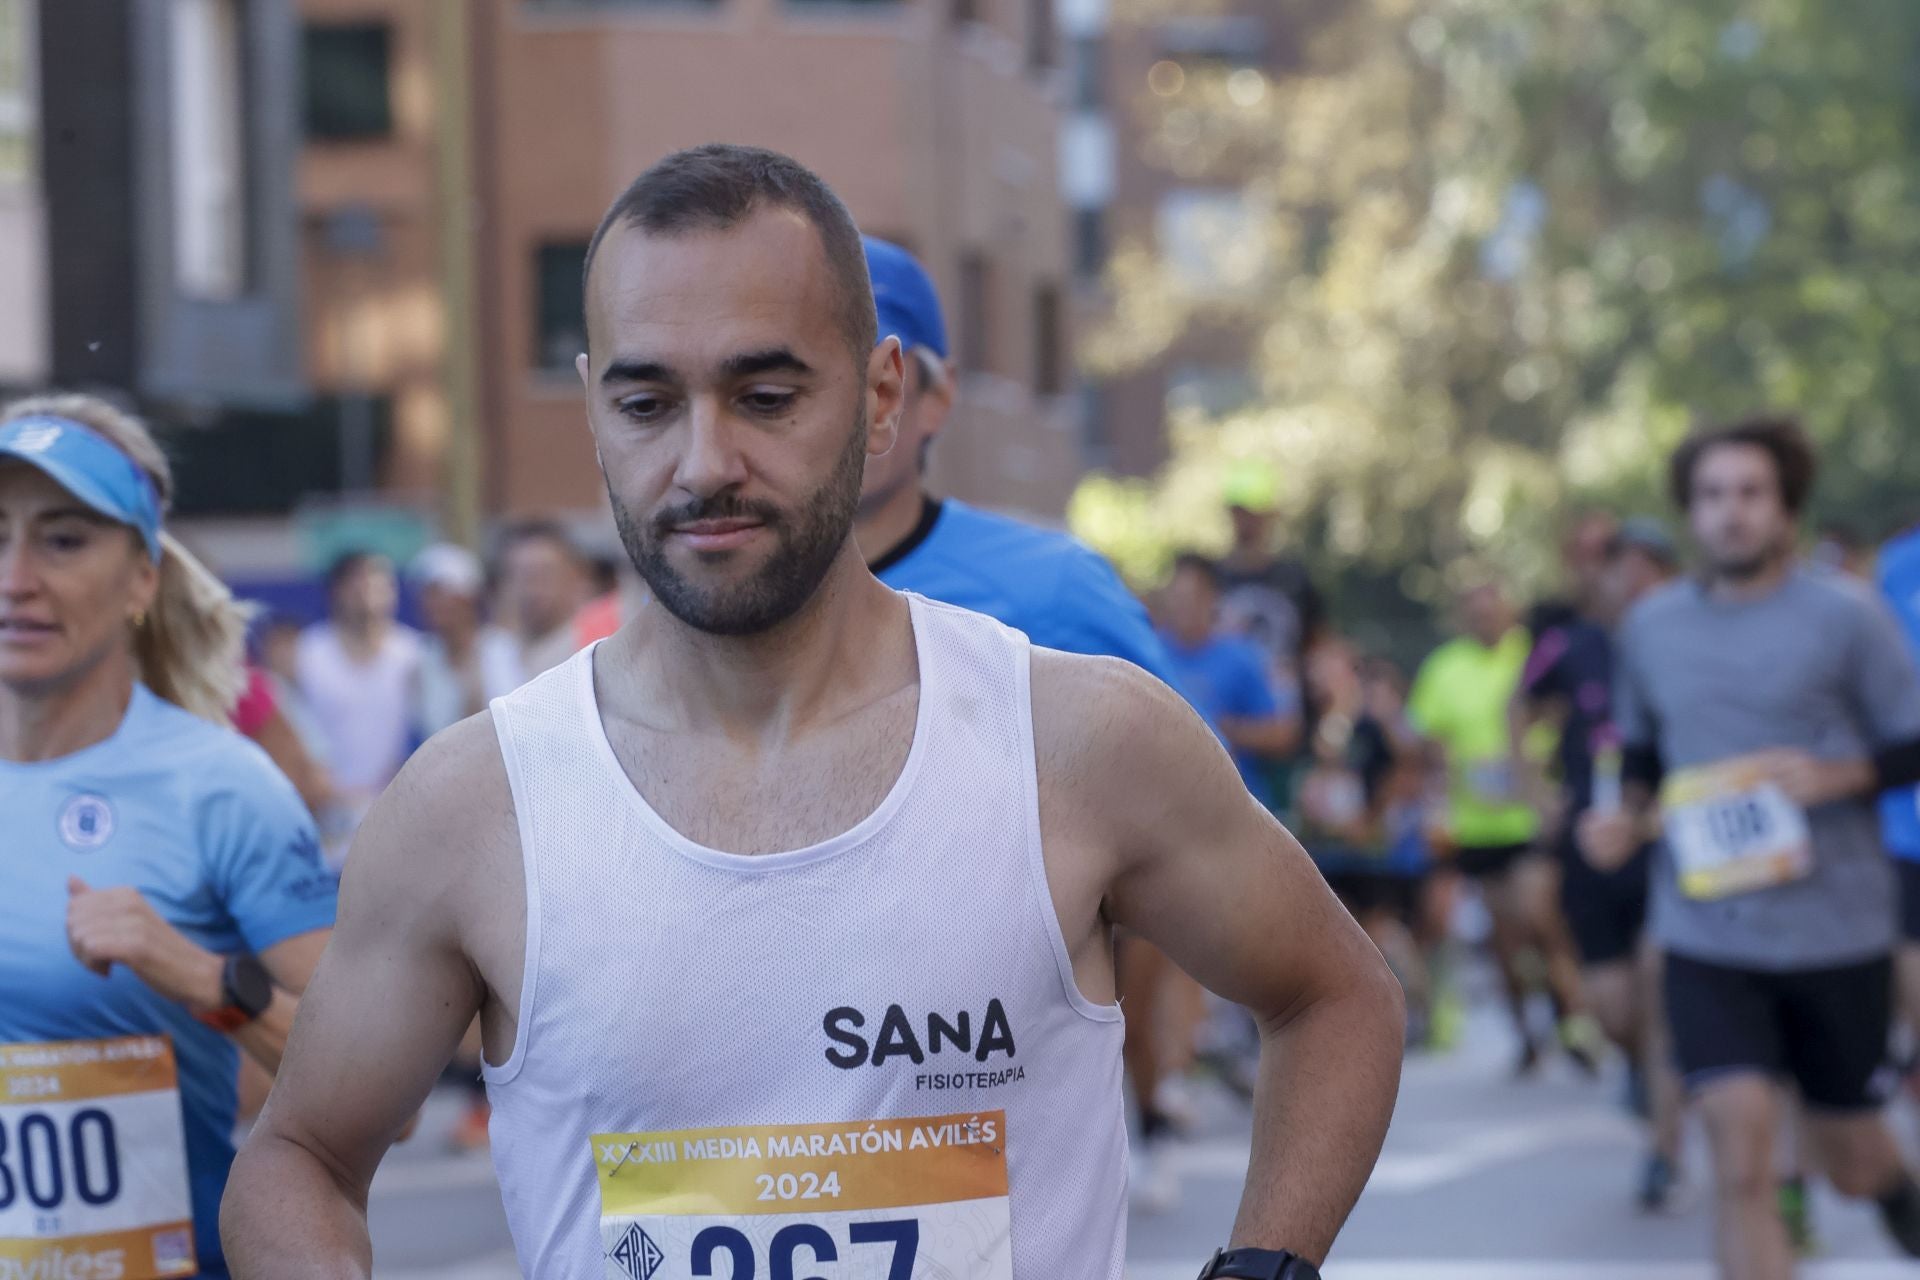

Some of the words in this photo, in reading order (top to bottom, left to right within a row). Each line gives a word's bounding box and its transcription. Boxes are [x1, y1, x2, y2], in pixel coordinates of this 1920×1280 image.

[823, 998, 1016, 1069] SANA
[916, 1066, 1025, 1090] FISIOTERAPIA
[600, 1141, 677, 1163] XXXIII
[683, 1136, 762, 1160] MEDIA
[767, 1123, 902, 1159] MARATÓN
[909, 1116, 997, 1150] AVILÉS
[755, 1171, 841, 1200] 2024
